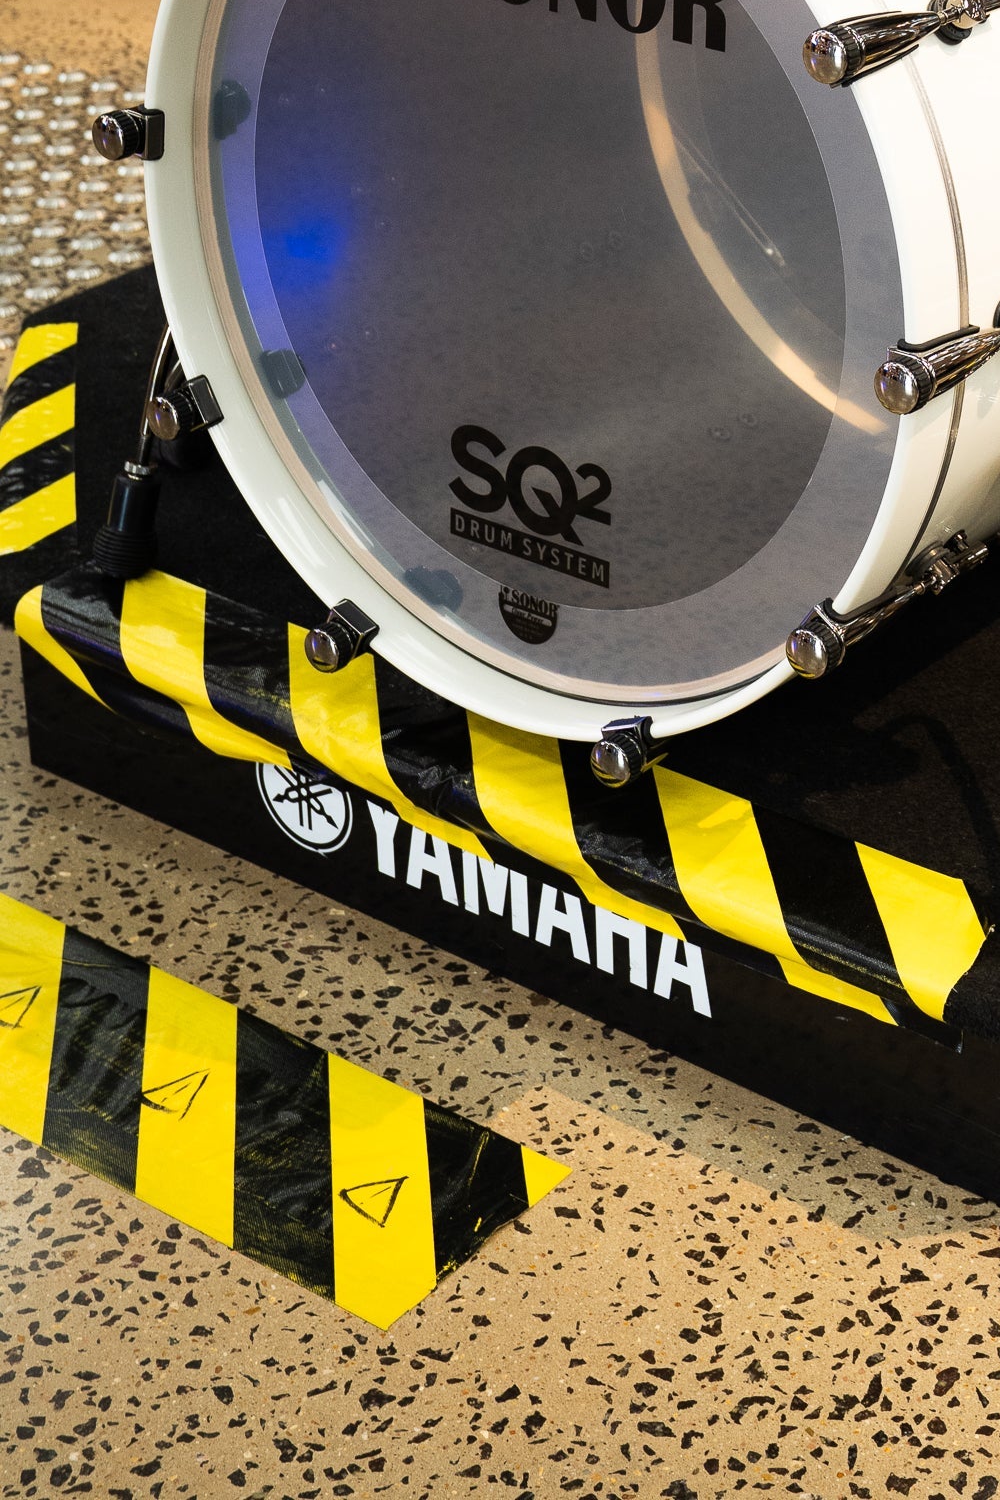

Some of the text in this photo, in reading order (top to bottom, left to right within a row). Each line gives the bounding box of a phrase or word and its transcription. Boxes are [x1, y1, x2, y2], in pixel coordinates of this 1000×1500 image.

[454, 514, 606, 582] DRUM SYSTEM
[366, 800, 712, 1019] YAMAHA
